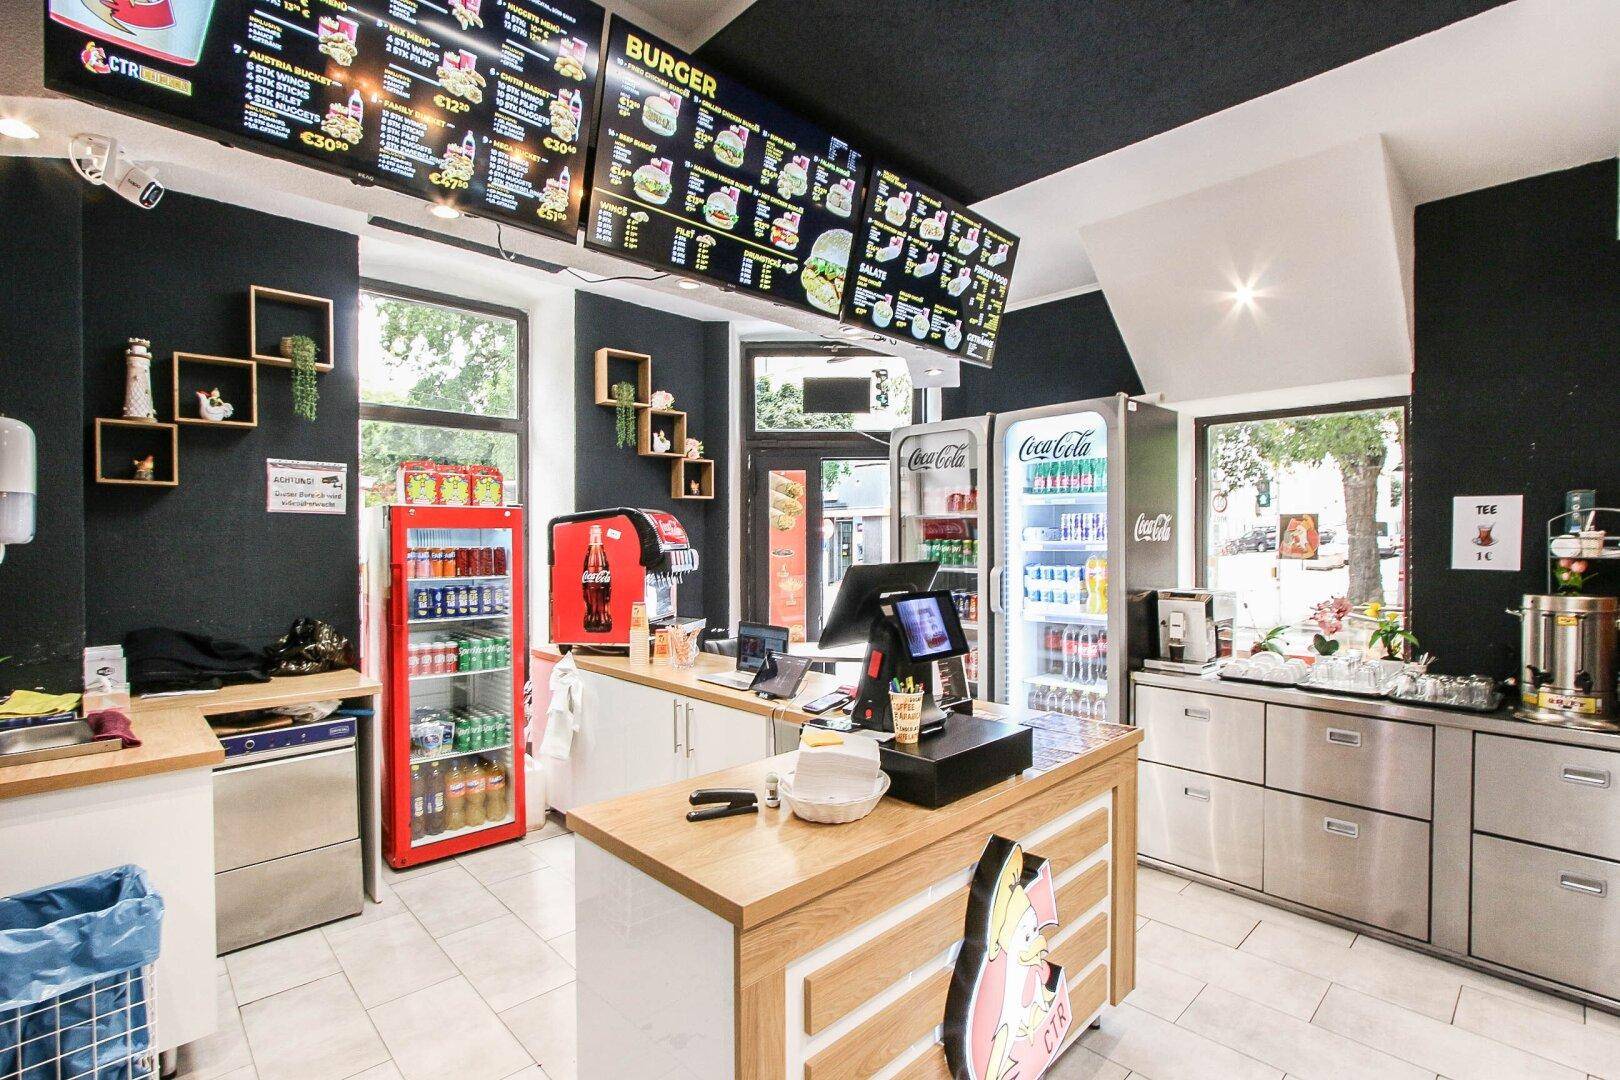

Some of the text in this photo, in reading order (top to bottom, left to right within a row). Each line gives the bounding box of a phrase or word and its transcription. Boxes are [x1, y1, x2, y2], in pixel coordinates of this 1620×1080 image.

[108, 55, 141, 80] CTR
[249, 51, 293, 73] AUSTRIA
[294, 66, 332, 86] BUCKET
[255, 63, 275, 79] STK
[275, 71, 311, 90] WINGS
[625, 33, 718, 99] BURGER
[254, 84, 275, 99] STK
[275, 91, 302, 107] FILET
[255, 74, 275, 89] STK
[275, 81, 310, 100] STICKS
[253, 94, 274, 109] STK
[274, 100, 321, 123] NUGGETS
[859, 262, 888, 281] SALATE
[908, 443, 970, 471] Coca-Cola
[1018, 430, 1096, 461] Coca-Cola
[1475, 504, 1498, 515] TEE
[1134, 512, 1173, 542] Coca-Cola
[1476, 552, 1482, 561] 1
[581, 569, 612, 584] Coca-Cola
[1043, 1001, 1068, 1055] CTR
